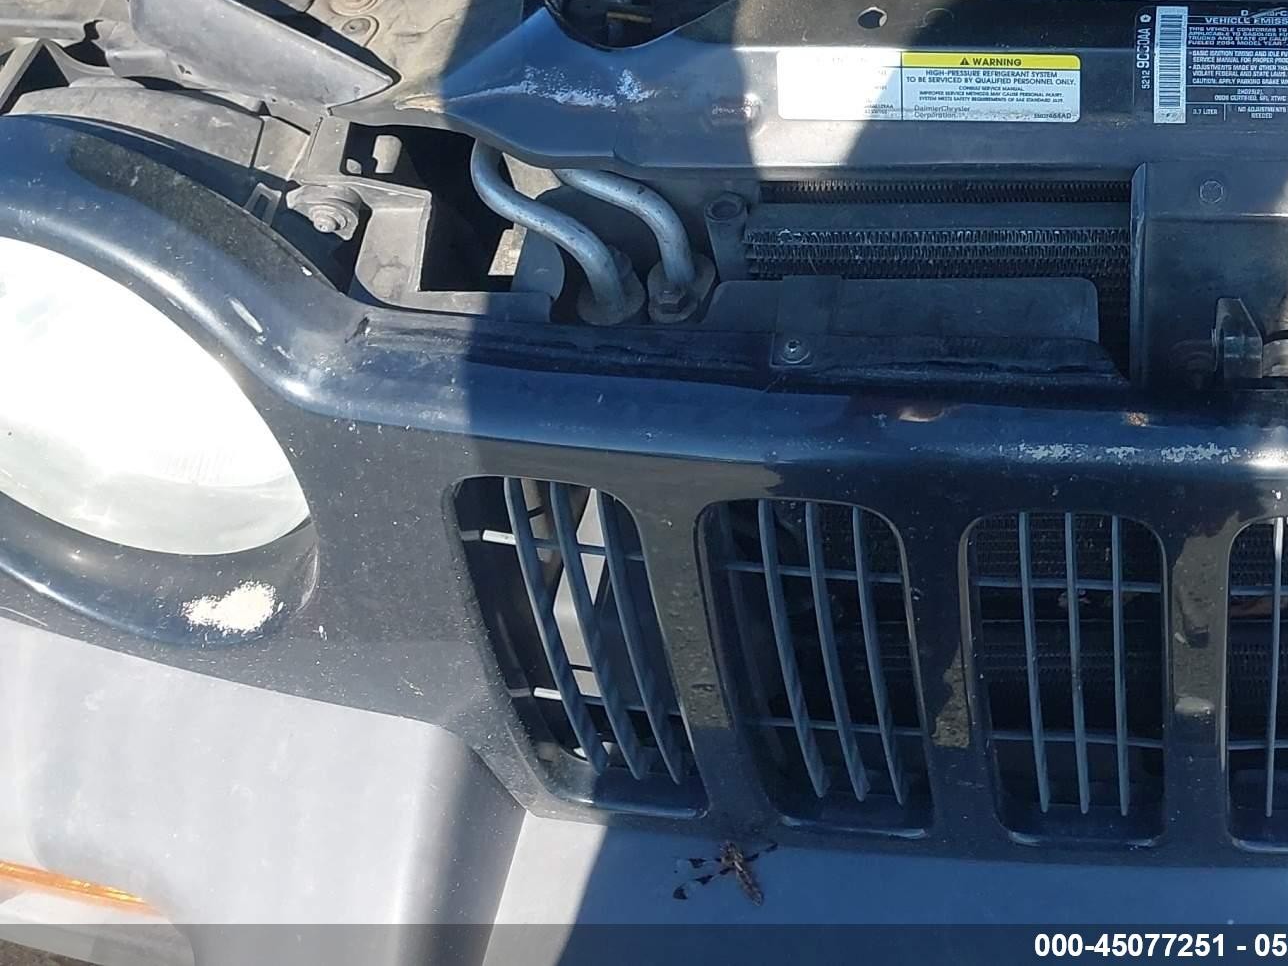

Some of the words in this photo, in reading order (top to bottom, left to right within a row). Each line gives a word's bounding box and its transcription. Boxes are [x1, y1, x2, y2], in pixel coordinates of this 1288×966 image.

[1205, 17, 1251, 25] VEHICLE
[972, 58, 1022, 66] WARNING
[1141, 70, 1150, 89] 5212
[915, 105, 970, 113] DaimlerChrysler
